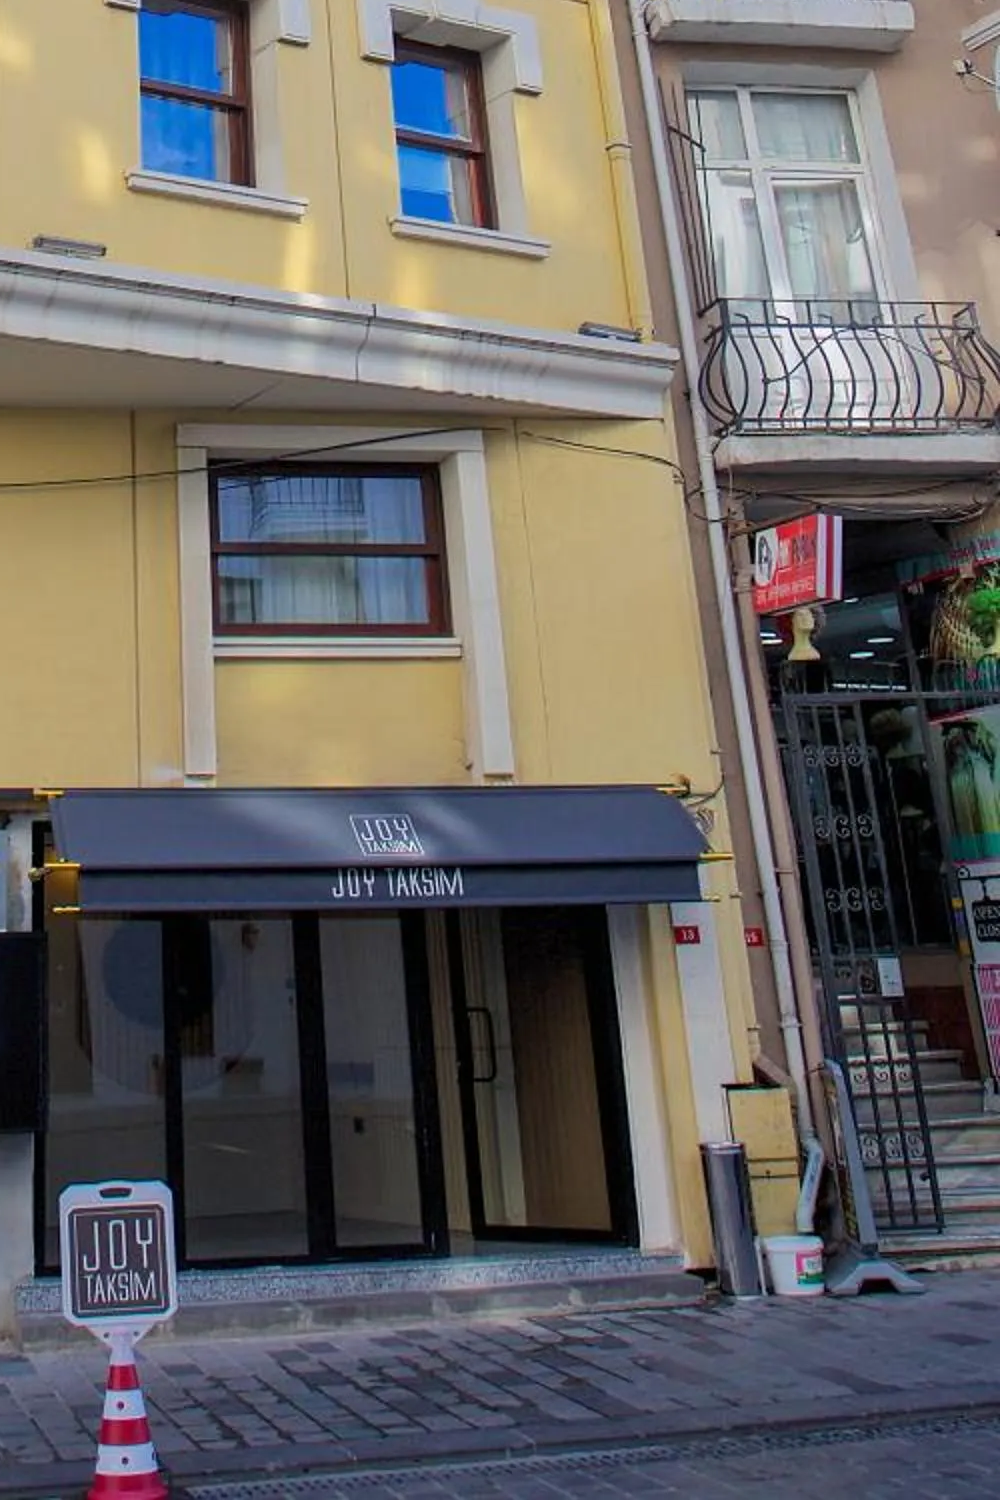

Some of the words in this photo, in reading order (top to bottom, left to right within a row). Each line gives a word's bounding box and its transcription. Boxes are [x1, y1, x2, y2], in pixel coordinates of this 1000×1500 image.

[360, 819, 409, 842] JOY
[332, 867, 375, 898] JOY
[384, 867, 465, 898] TAKSIM
[83, 1218, 153, 1272] JOY
